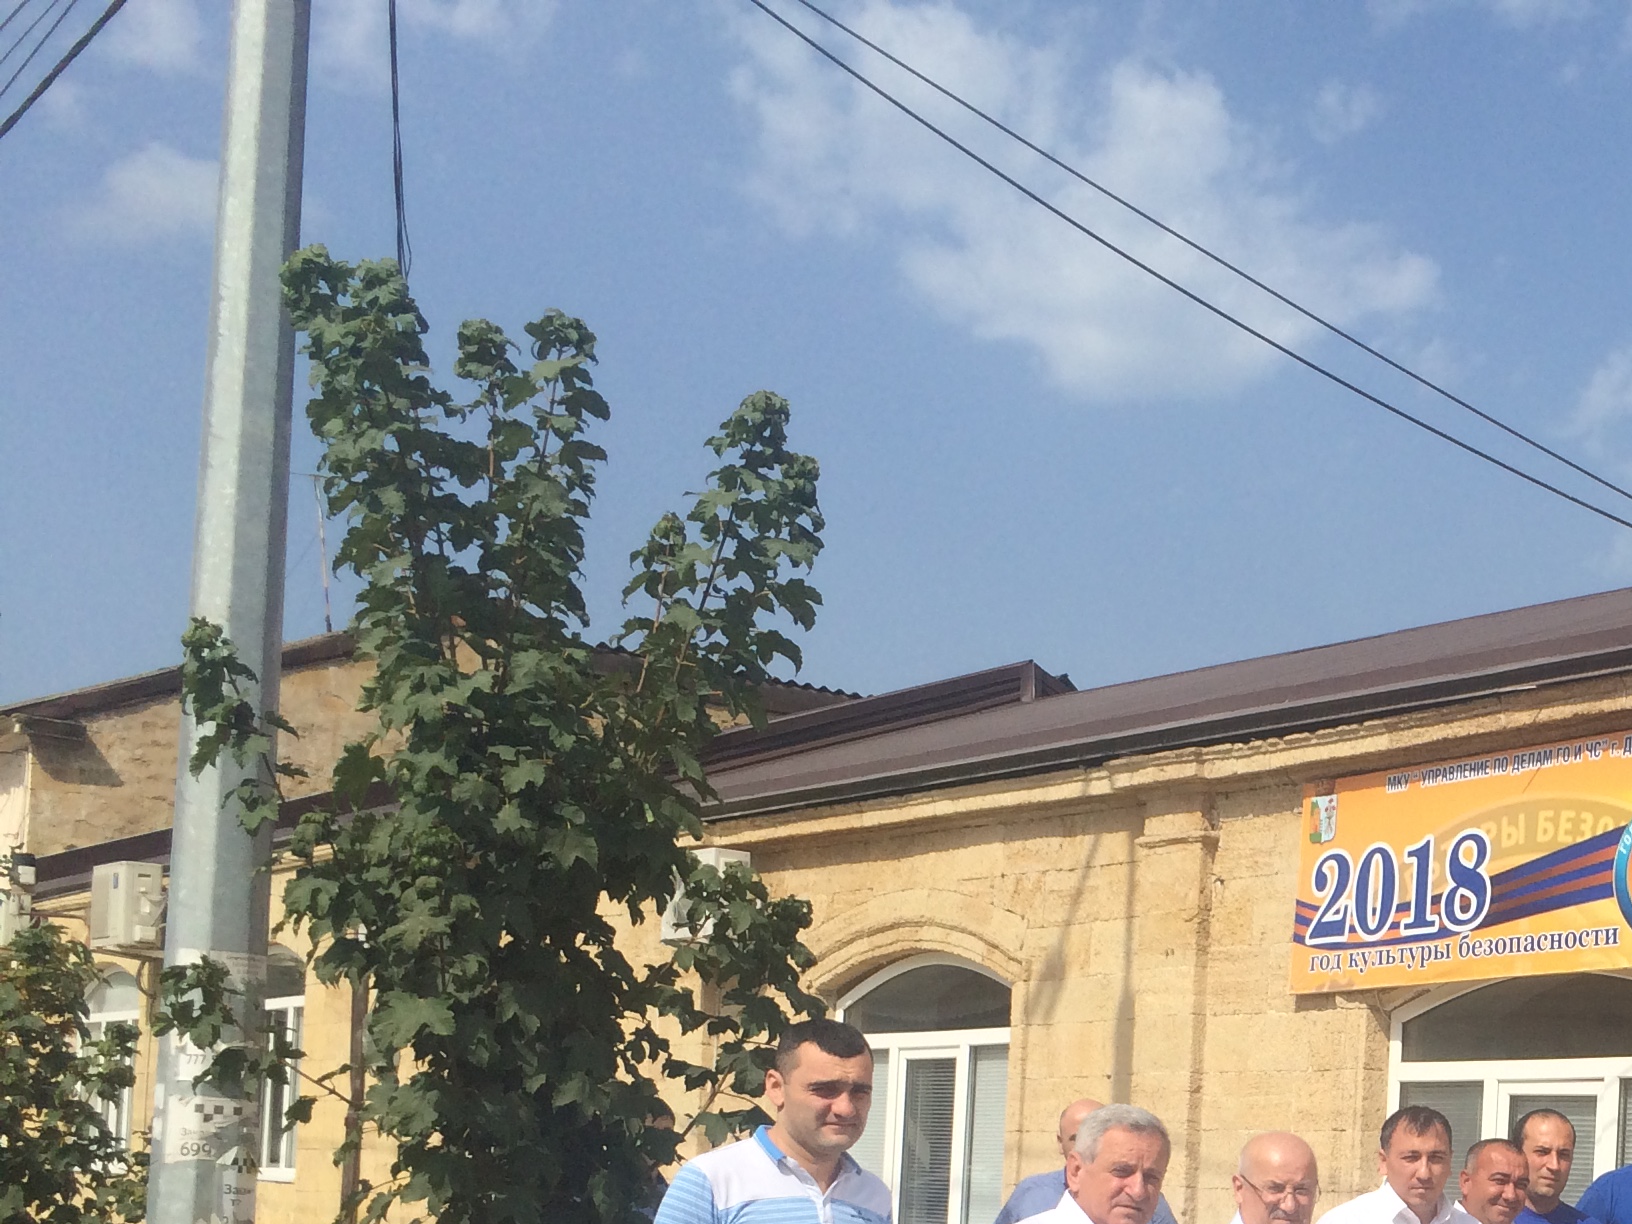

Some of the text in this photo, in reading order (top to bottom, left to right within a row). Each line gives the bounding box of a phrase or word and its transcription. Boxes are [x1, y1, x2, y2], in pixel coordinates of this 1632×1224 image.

[1387, 773, 1411, 792] МКУ
[1493, 756, 1509, 774] ПО
[1511, 750, 1553, 774] ДЕЛАМ
[1556, 746, 1571, 765] ГО
[1573, 744, 1583, 761] И
[1610, 740, 1620, 756] г.
[1306, 831, 1490, 943] 2018
[1309, 927, 1620, 974] год культуры безопасности
